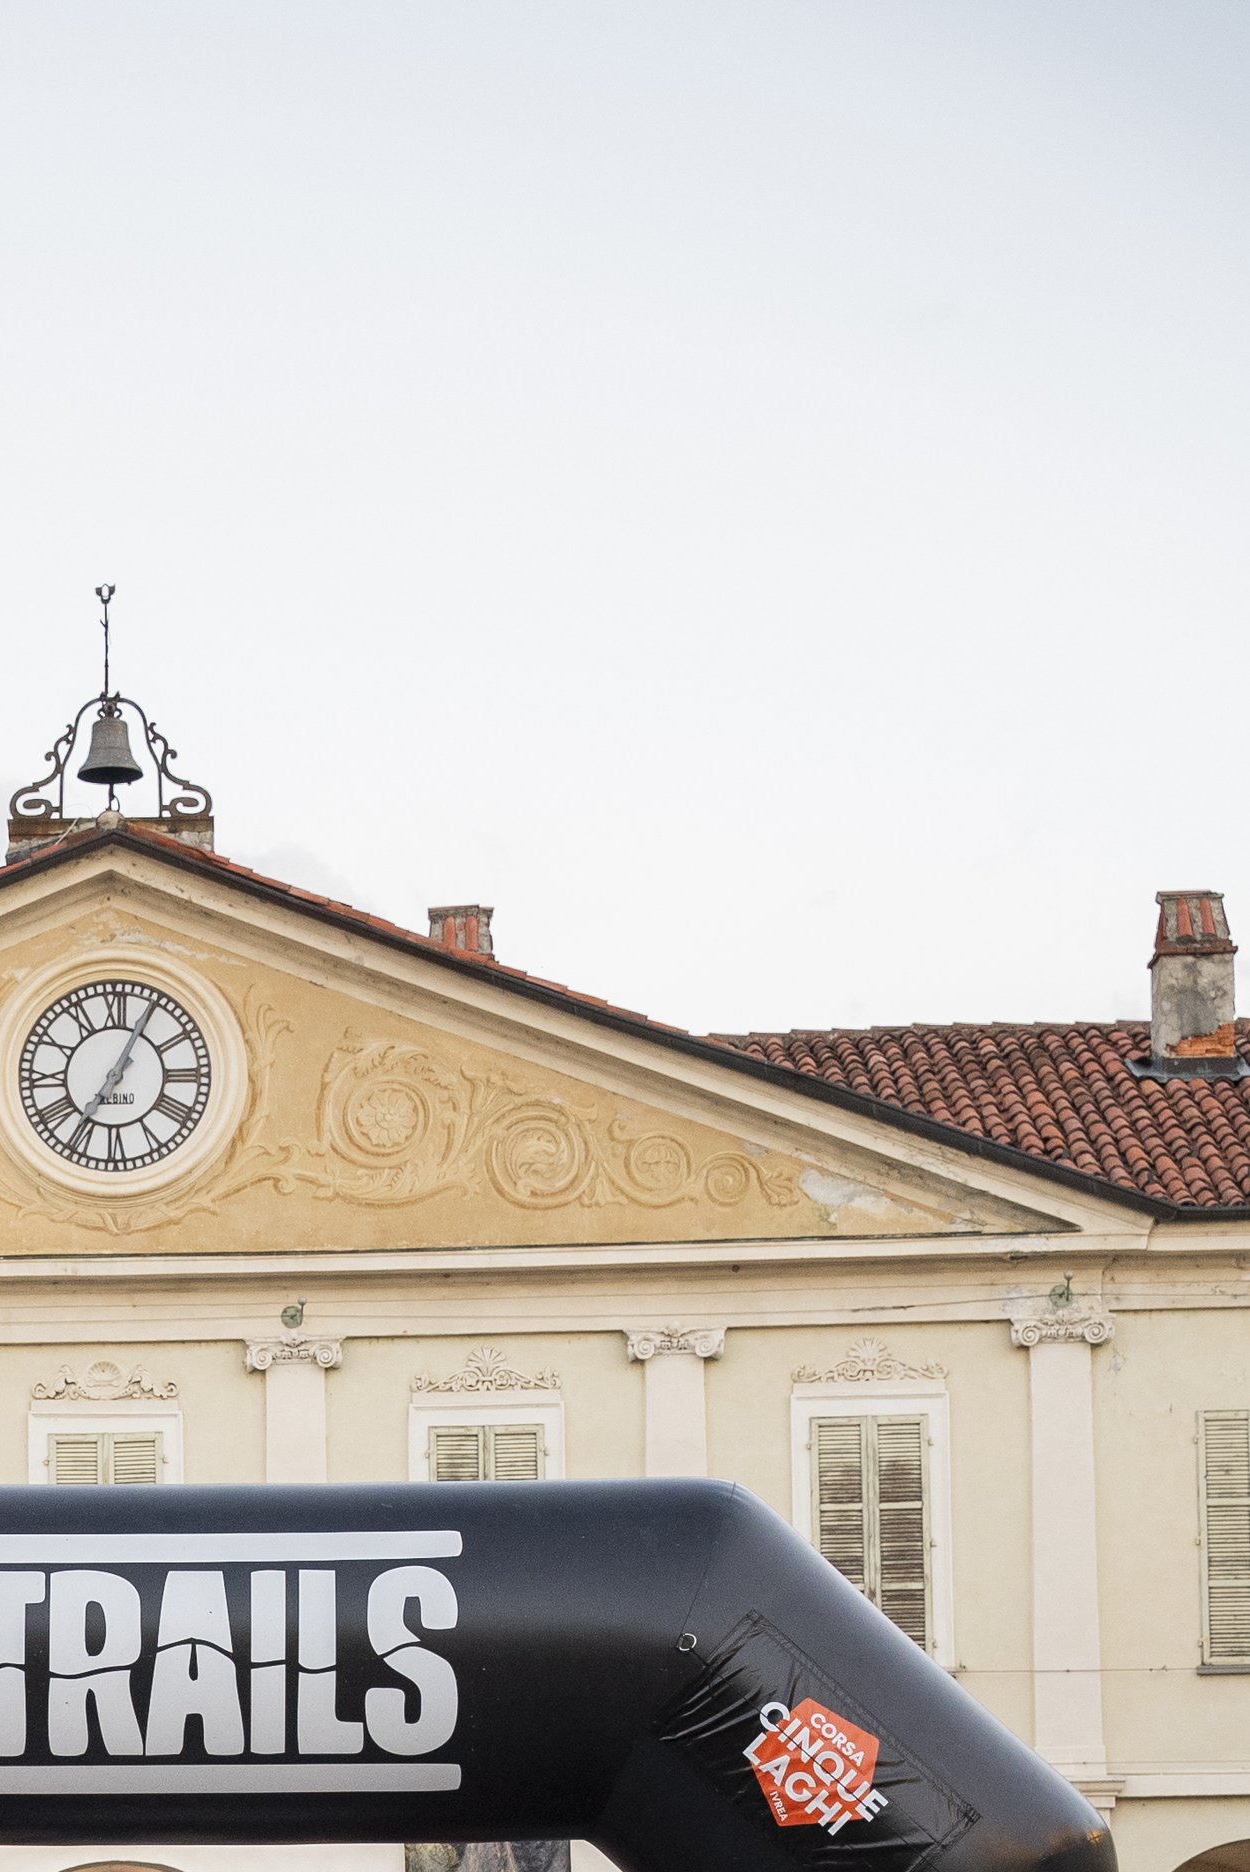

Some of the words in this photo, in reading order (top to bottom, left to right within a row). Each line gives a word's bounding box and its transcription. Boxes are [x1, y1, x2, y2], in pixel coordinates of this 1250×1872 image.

[760, 1701, 889, 1823] CINQUE
[810, 1713, 864, 1767] CORSA
[742, 1732, 852, 1836] LAGHI
[769, 1790, 789, 1822] IVREA
